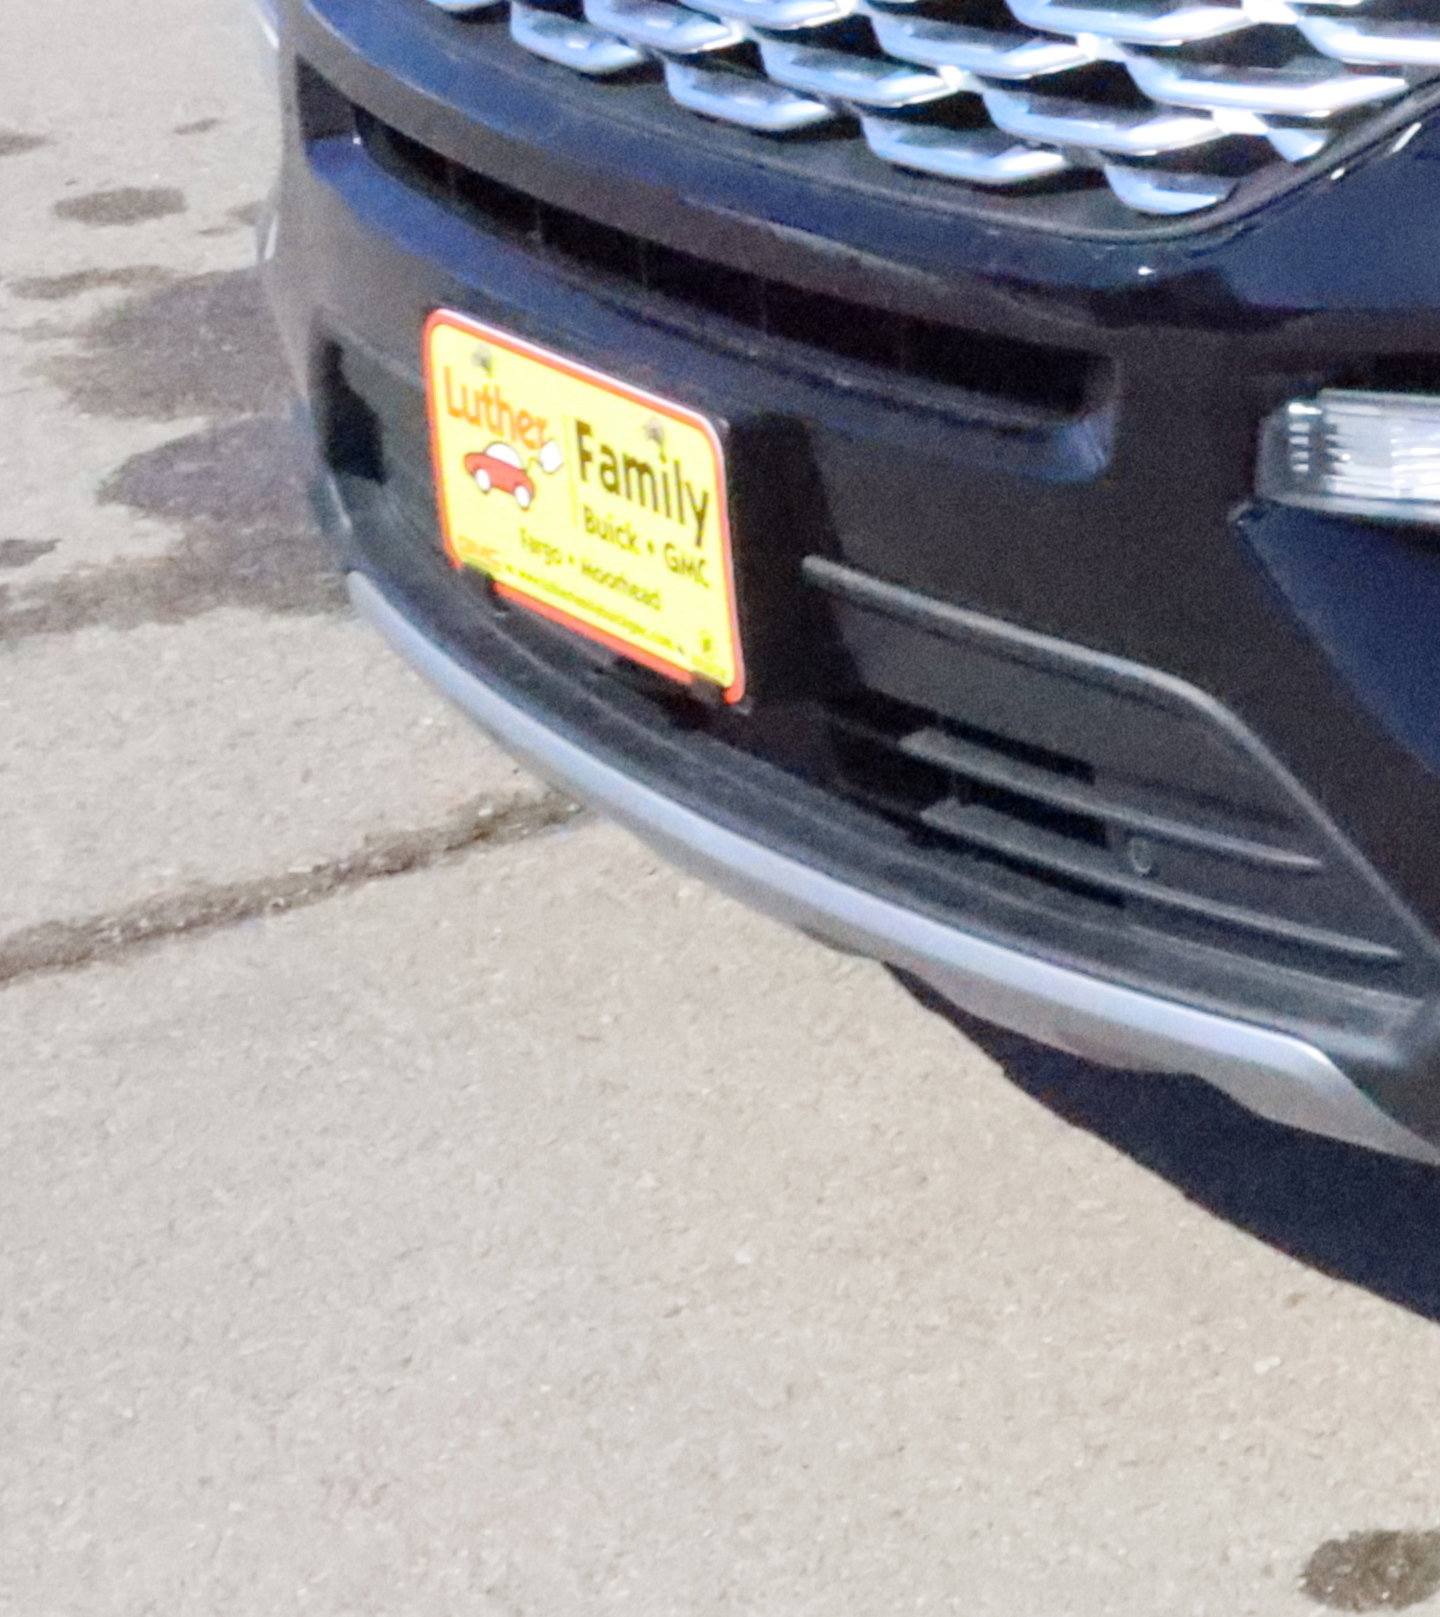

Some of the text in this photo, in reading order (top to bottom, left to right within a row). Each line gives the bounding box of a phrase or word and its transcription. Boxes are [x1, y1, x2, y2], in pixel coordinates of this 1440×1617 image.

[444, 365, 549, 451] Luther
[575, 418, 709, 548] Family
[584, 505, 711, 590] Buick GMC
